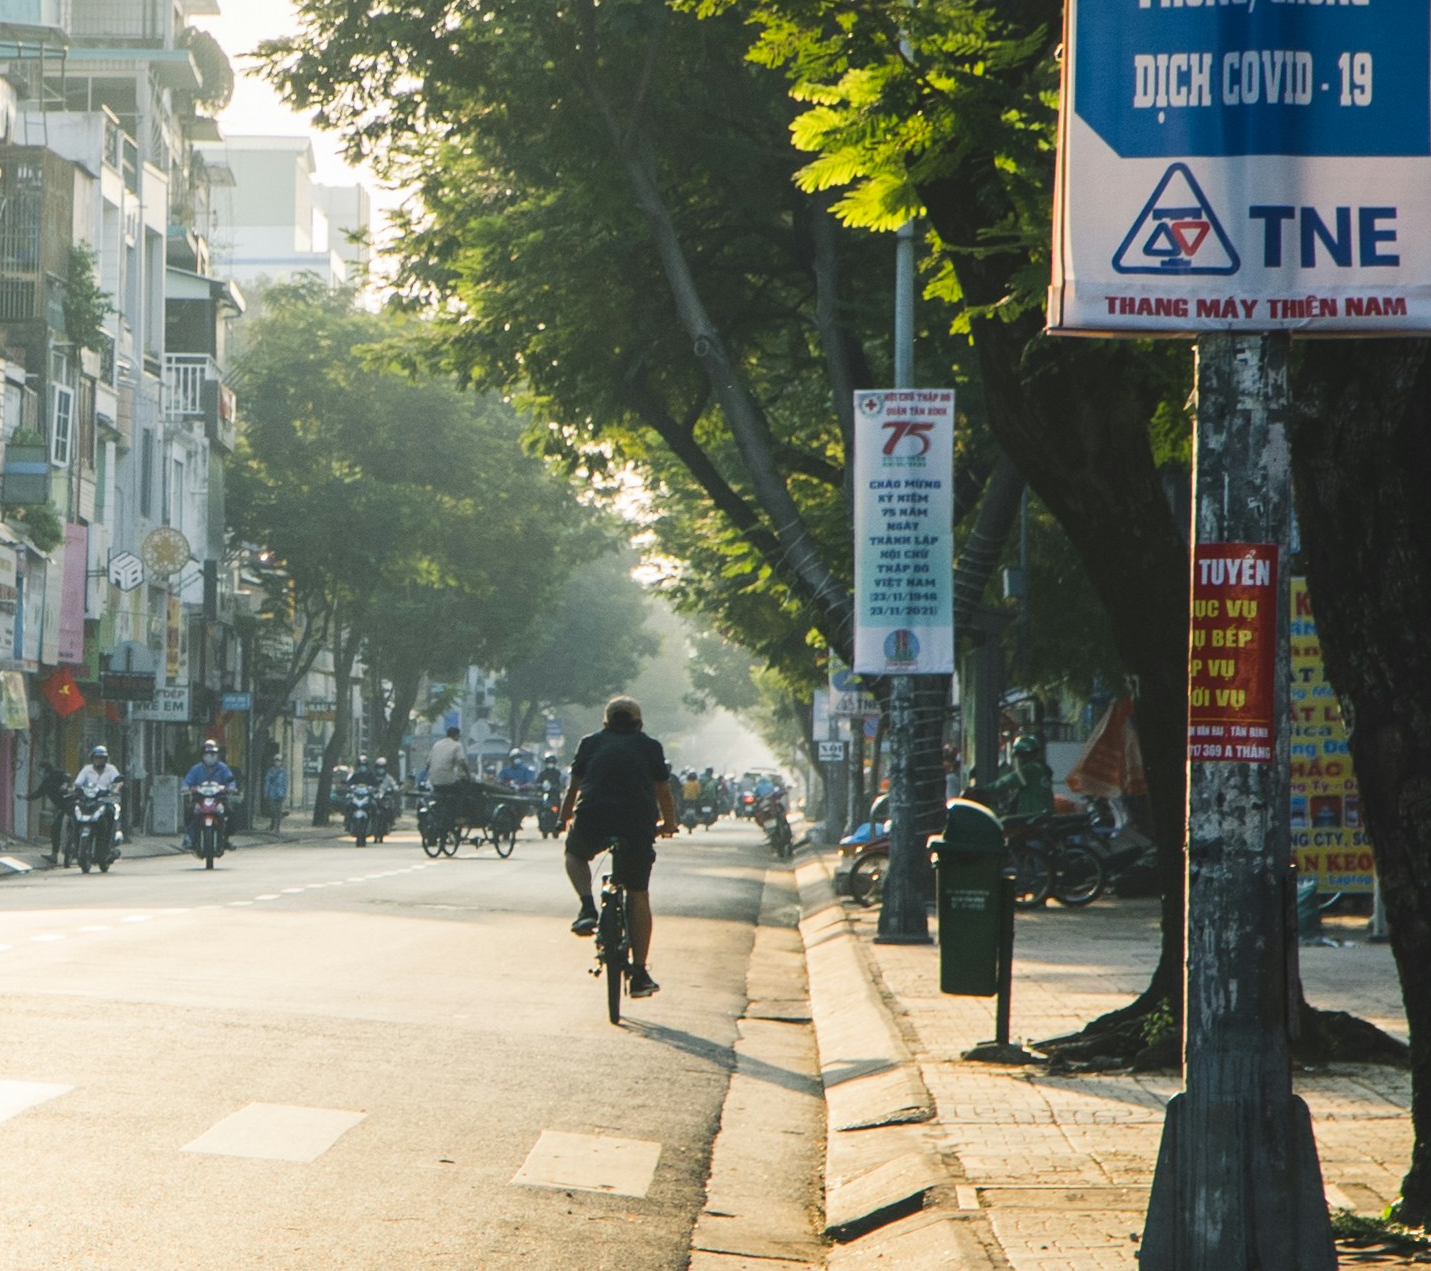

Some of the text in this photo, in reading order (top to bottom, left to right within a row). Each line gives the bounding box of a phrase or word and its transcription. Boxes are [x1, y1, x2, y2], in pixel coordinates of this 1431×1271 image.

[1134, 53, 1212, 125] DỊCH
[1222, 51, 1312, 106] COVID
[1338, 53, 1373, 107] 19
[1249, 206, 1400, 268] TNE
[1104, 294, 1408, 320] THANG MÁY THIÊN NAM
[882, 420, 935, 456] 75
[1198, 548, 1271, 587] TUYỂN
[874, 577, 936, 589] VIỆT NAM
[1225, 598, 1259, 622] VỤ
[1207, 658, 1236, 682] VỤ
[1215, 688, 1247, 712] VỤ
